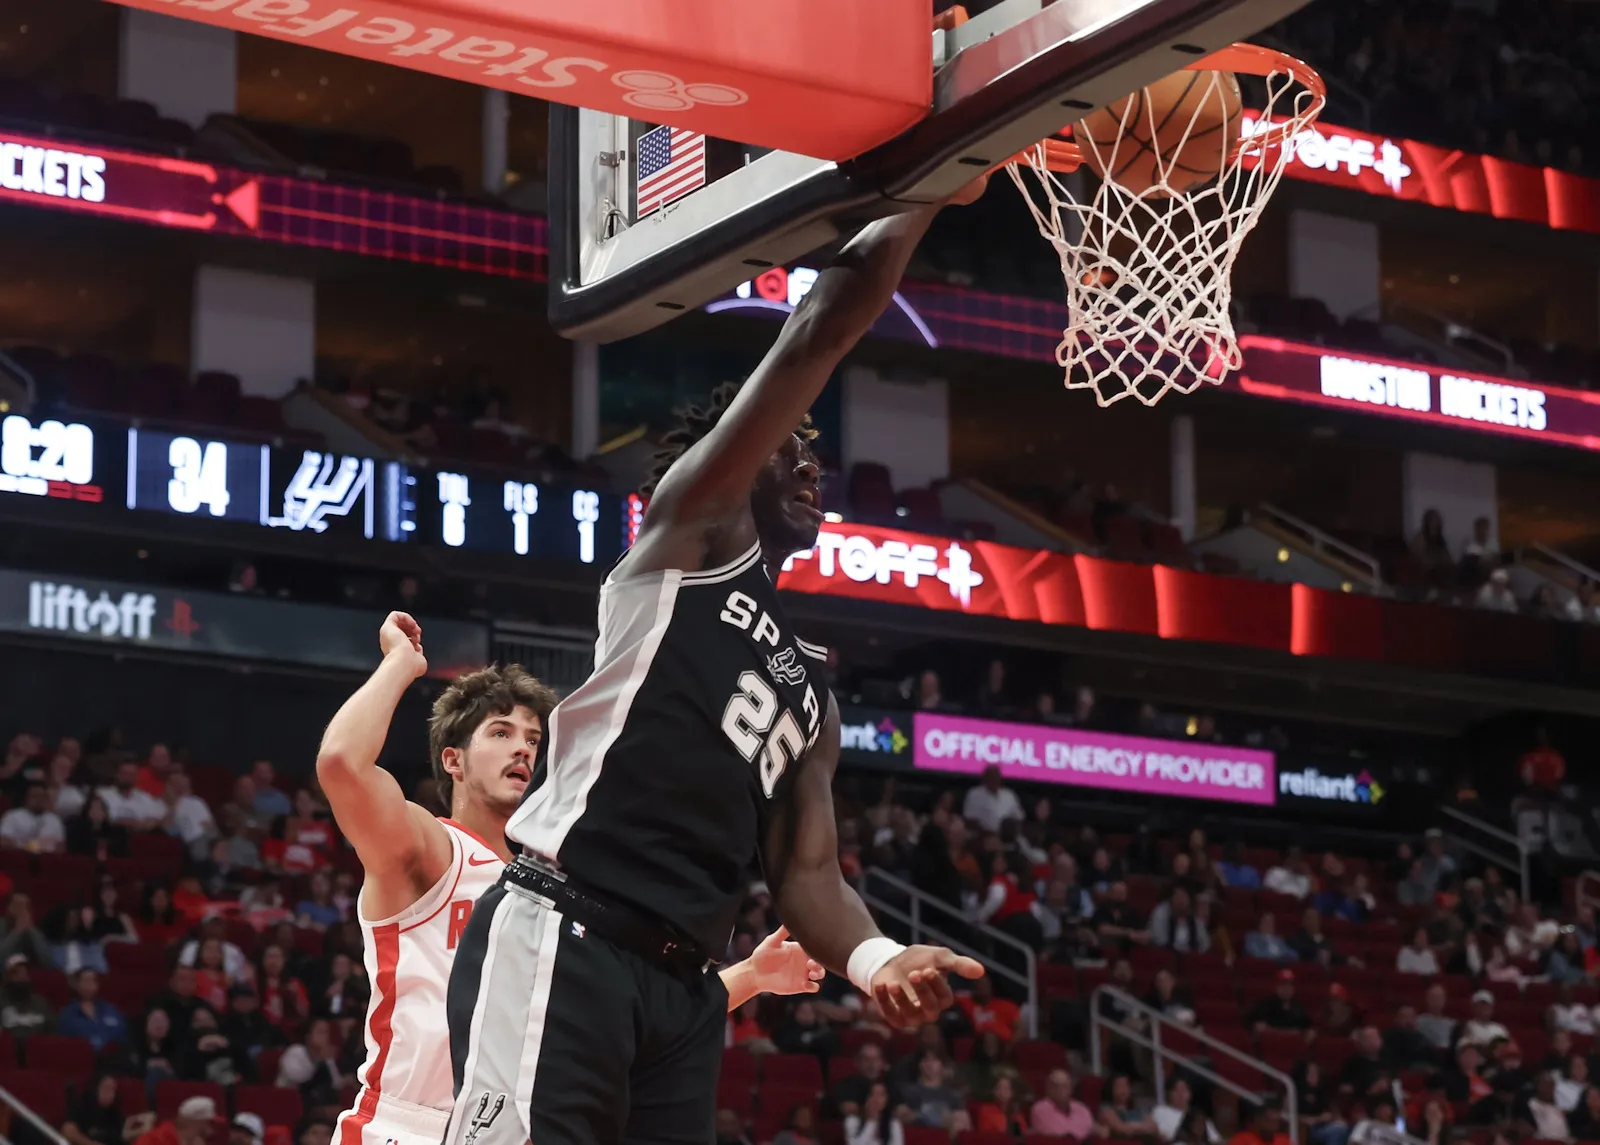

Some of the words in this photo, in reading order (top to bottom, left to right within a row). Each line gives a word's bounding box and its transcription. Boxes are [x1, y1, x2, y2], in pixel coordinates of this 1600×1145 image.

[0, 141, 106, 203] CKETS
[1439, 374, 1547, 431] ROCKETS
[168, 436, 230, 517] 34
[512, 512, 529, 555] 1
[577, 520, 595, 563] 1
[29, 581, 156, 640] liftoff
[721, 670, 807, 799] 25
[924, 728, 1041, 768] OFFICIAL
[1045, 741, 1143, 778] ENERGY
[1145, 753, 1265, 790] PROVIDER
[1279, 767, 1357, 802] reliant
